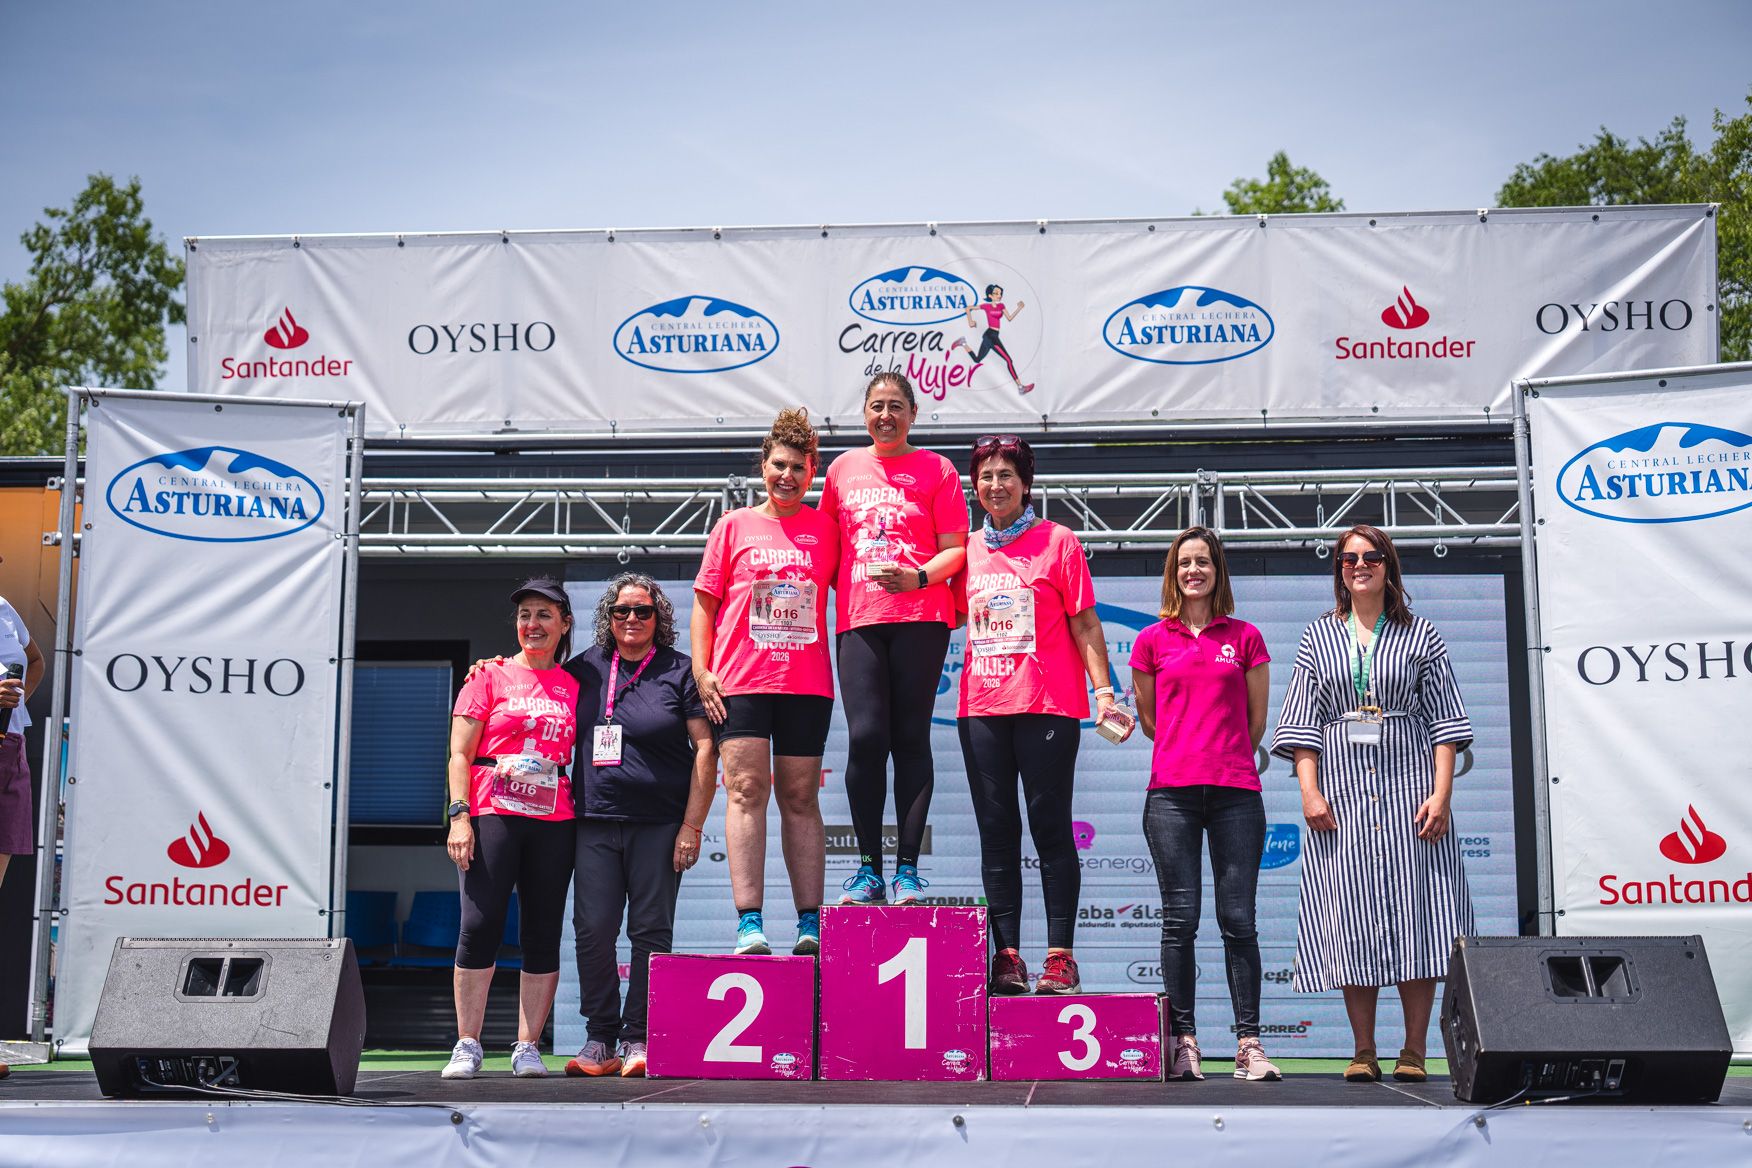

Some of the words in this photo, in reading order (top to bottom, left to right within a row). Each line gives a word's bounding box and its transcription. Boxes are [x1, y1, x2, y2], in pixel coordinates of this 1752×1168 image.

[860, 289, 967, 311] ASTURIANA
[651, 322, 702, 330] CENTRAL
[708, 321, 761, 329] LECHERA
[1142, 312, 1195, 321] CENTRAL
[1201, 312, 1256, 320] LECHERA
[1536, 299, 1692, 334] OYSHO
[408, 321, 556, 354] OYSHO
[626, 325, 767, 354] ASTURIANA
[839, 323, 945, 354] Carrera
[1116, 316, 1262, 345] ASTURIANA
[1335, 336, 1475, 360] Santander
[221, 356, 352, 379] Santander
[864, 355, 882, 376] de
[889, 354, 902, 373] la
[905, 350, 983, 401] Mujer
[1607, 457, 1679, 469] CENTRAL
[1687, 452, 1752, 464] LECHER
[158, 475, 226, 488] CENTRAL
[234, 480, 302, 491] LECHERA
[1574, 464, 1752, 501] ASTURIAN
[122, 477, 308, 520] ASTURIANA
[845, 487, 906, 505] CARRERA
[750, 549, 813, 567] CARRERA
[969, 573, 1021, 591] CARRERA
[773, 608, 798, 619] 016
[990, 619, 1013, 631] 016
[771, 651, 790, 661] 2026
[971, 656, 1016, 676] MUJER
[106, 654, 305, 697] OYSHO
[983, 678, 1001, 688] 2026
[508, 697, 572, 715] CARRERA
[510, 781, 537, 795] 016
[1459, 837, 1490, 845] reos
[1461, 849, 1491, 857] ress
[104, 876, 289, 907] Santander
[1599, 872, 1752, 905] Santand
[877, 938, 927, 1050] 1
[703, 972, 764, 1063] 2
[1057, 1004, 1101, 1072] 3
[1259, 1025, 1307, 1033] ORREO
